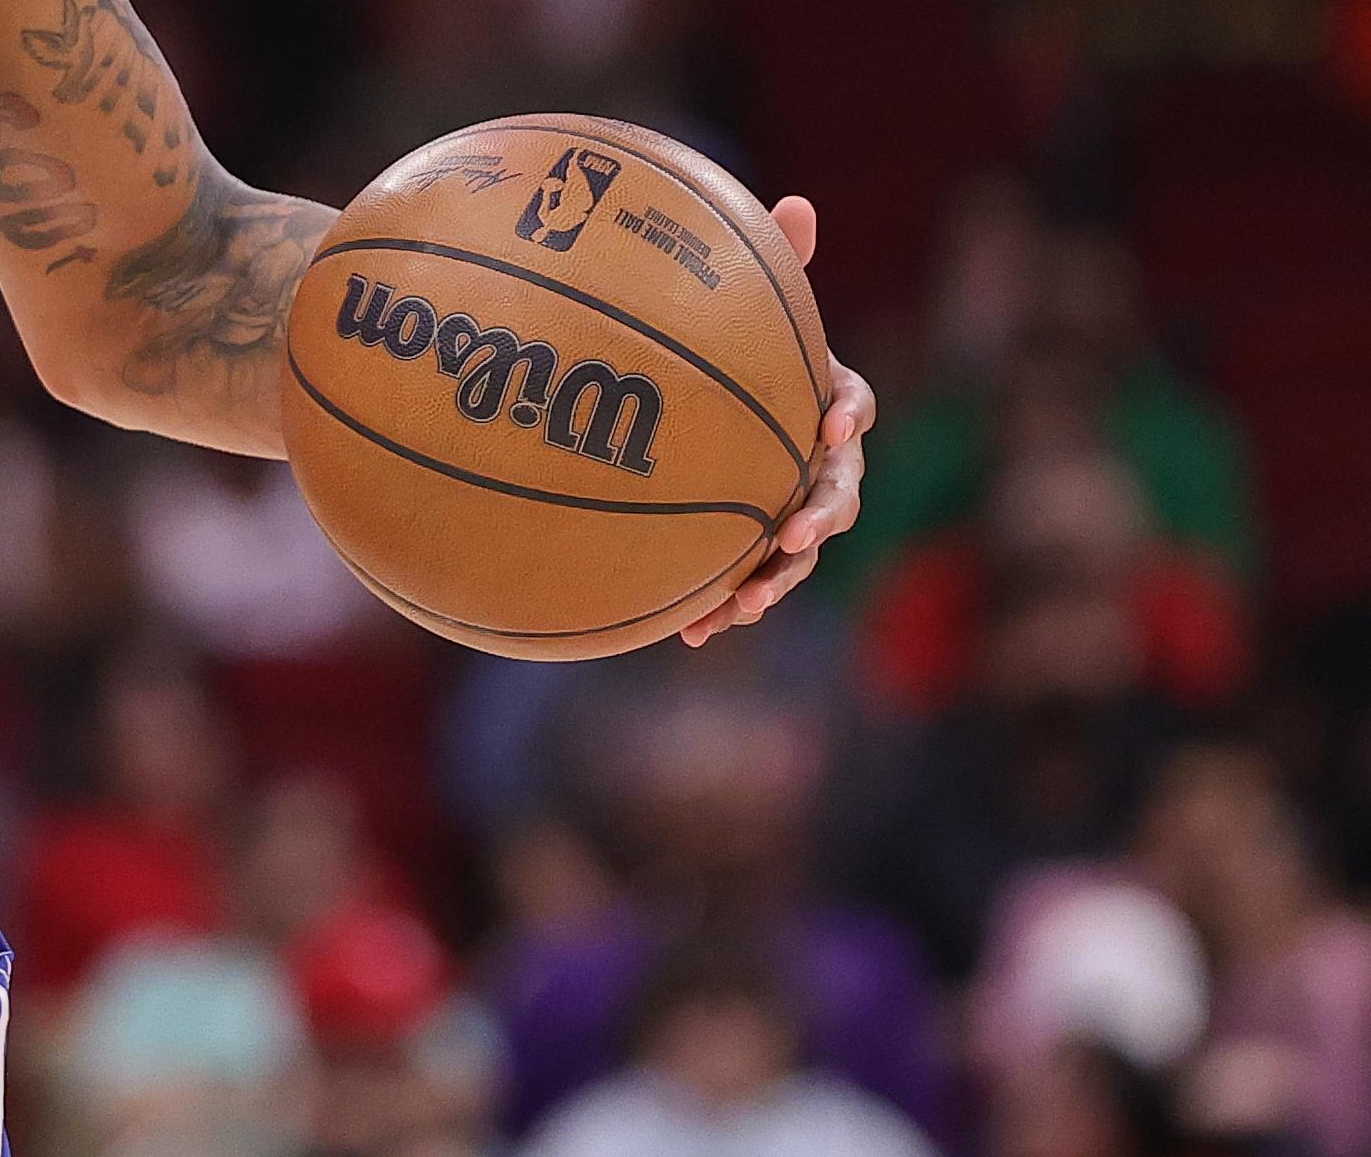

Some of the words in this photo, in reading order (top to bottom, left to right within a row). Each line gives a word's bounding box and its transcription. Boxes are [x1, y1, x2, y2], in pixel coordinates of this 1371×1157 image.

[614, 208, 645, 234] BALL
[641, 223, 678, 254] GAME
[335, 273, 664, 477] Wilson
